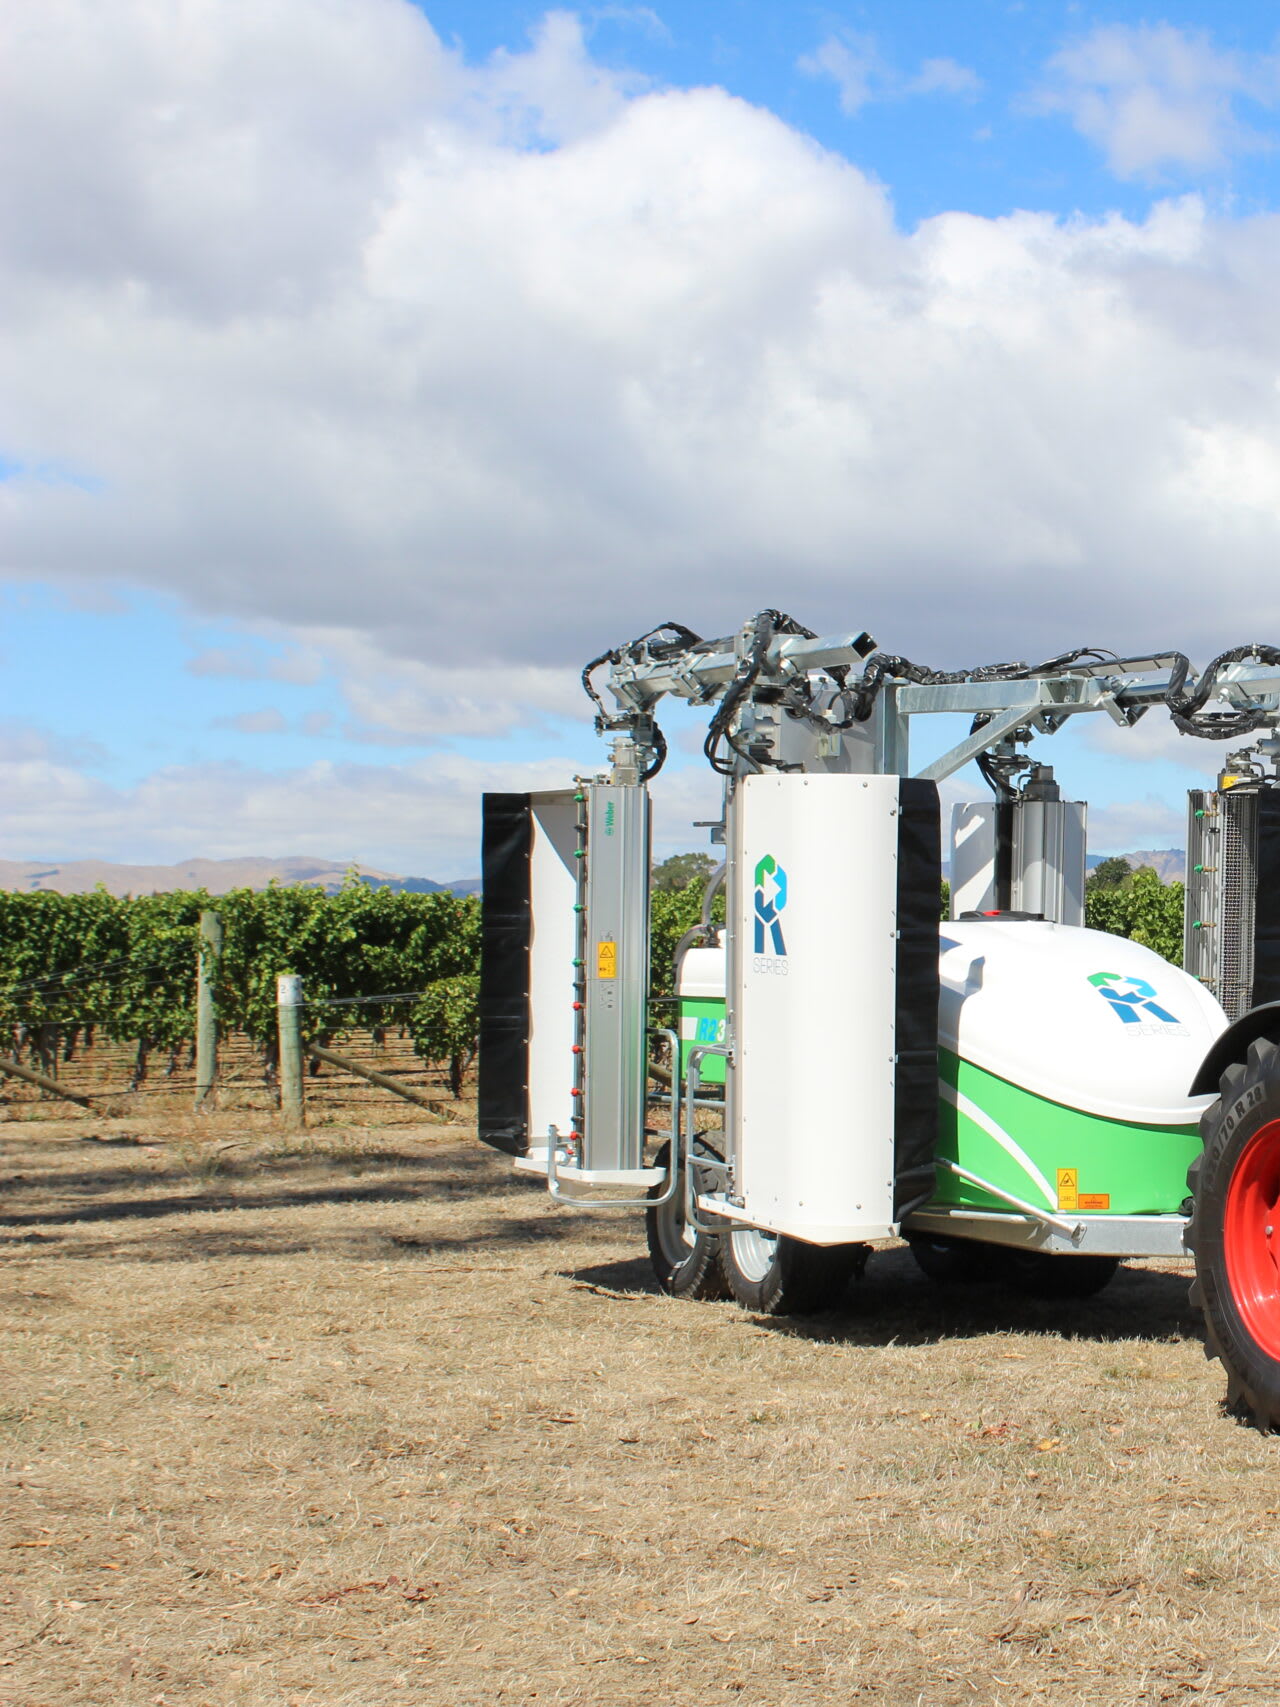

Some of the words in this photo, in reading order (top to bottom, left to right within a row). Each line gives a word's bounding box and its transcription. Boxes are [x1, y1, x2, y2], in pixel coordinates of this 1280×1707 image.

[753, 957, 789, 976] SERIES
[1126, 1024, 1191, 1037] SERIES
[1234, 1100, 1247, 1119] R
[1246, 1085, 1264, 1107] 28
